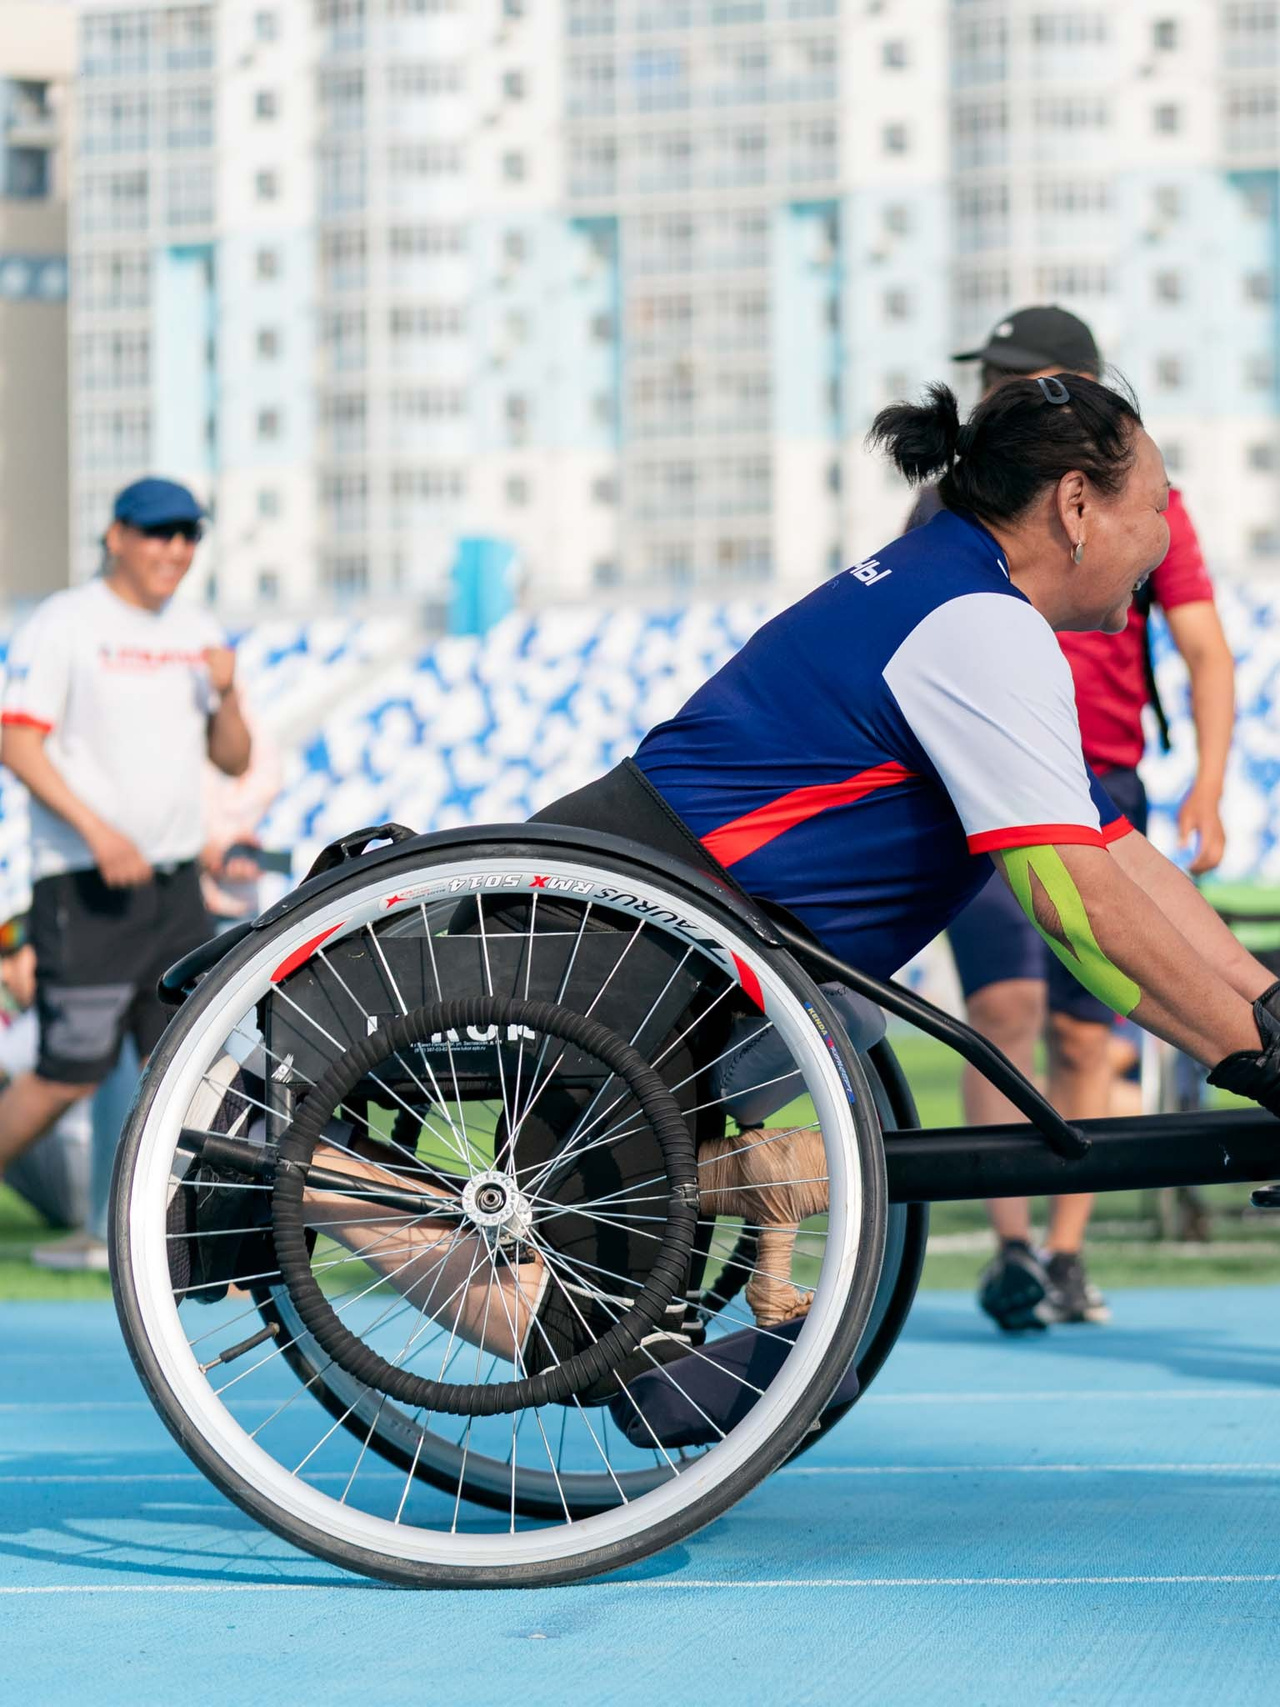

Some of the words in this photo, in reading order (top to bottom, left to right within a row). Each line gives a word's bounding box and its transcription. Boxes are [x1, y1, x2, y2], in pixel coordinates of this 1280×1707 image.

[449, 874, 522, 893] 5014
[528, 875, 596, 896] RMX
[594, 887, 728, 964] TAURUS
[807, 1007, 828, 1036] KENDA
